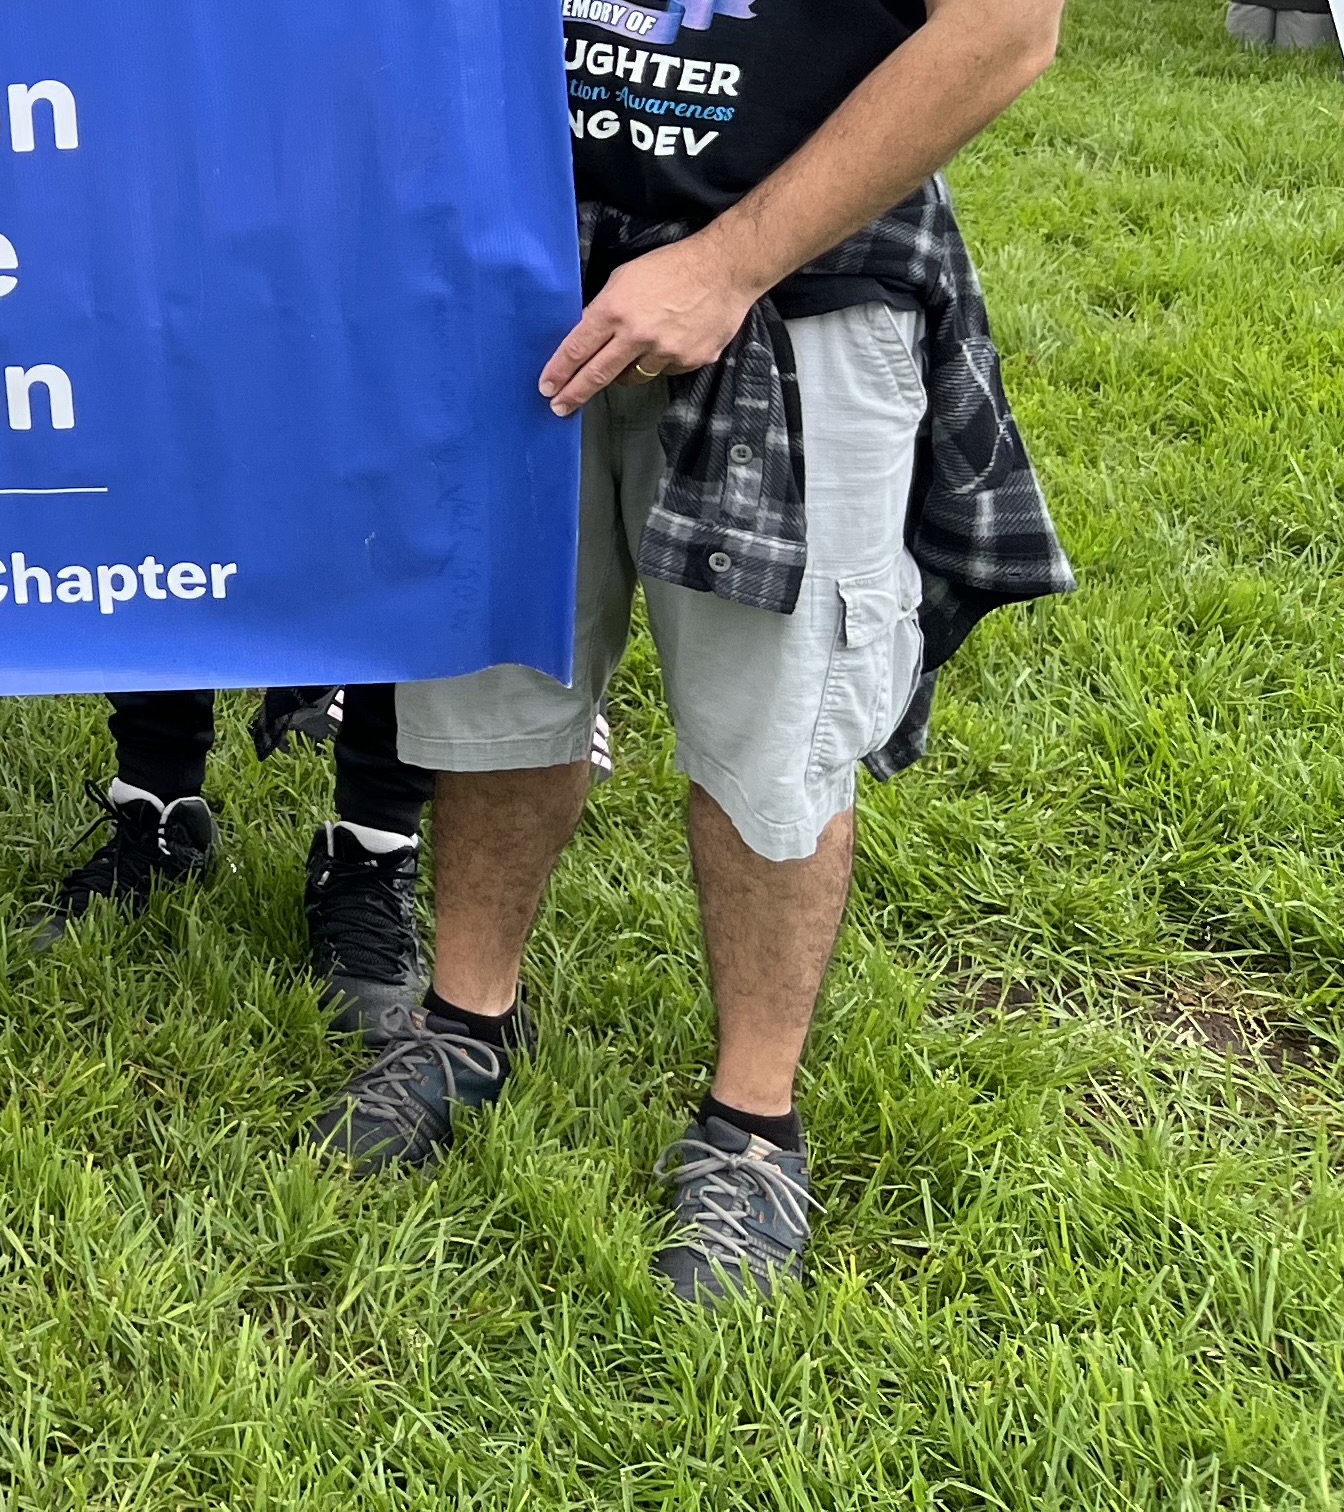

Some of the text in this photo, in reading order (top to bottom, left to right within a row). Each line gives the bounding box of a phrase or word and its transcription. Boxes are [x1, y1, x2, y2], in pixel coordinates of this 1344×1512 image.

[624, 11, 657, 35] OF
[615, 85, 735, 122] Awareness
[629, 119, 720, 156] DEV
